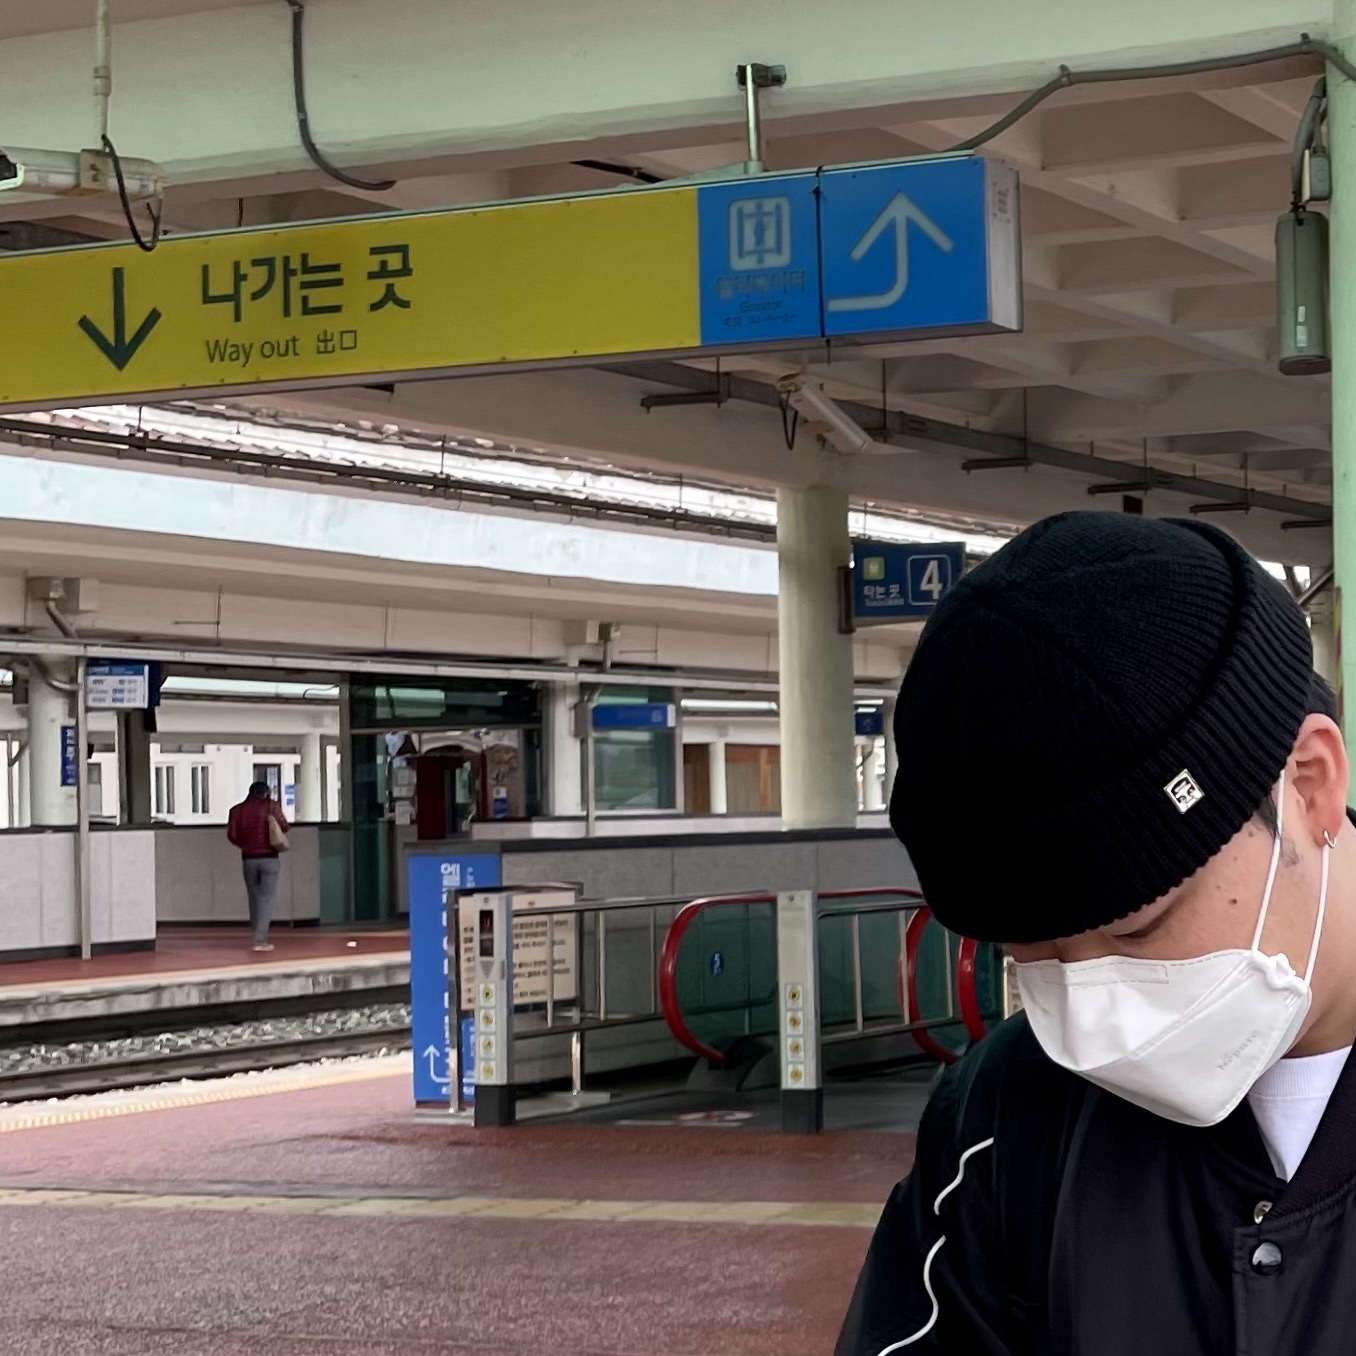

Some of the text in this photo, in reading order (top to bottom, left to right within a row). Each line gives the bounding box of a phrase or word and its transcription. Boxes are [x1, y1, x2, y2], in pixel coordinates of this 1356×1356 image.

[201, 243, 413, 323] 나가는 곳
[205, 335, 300, 368] Way out
[316, 329, 358, 355] 出口
[920, 560, 943, 600] 4
